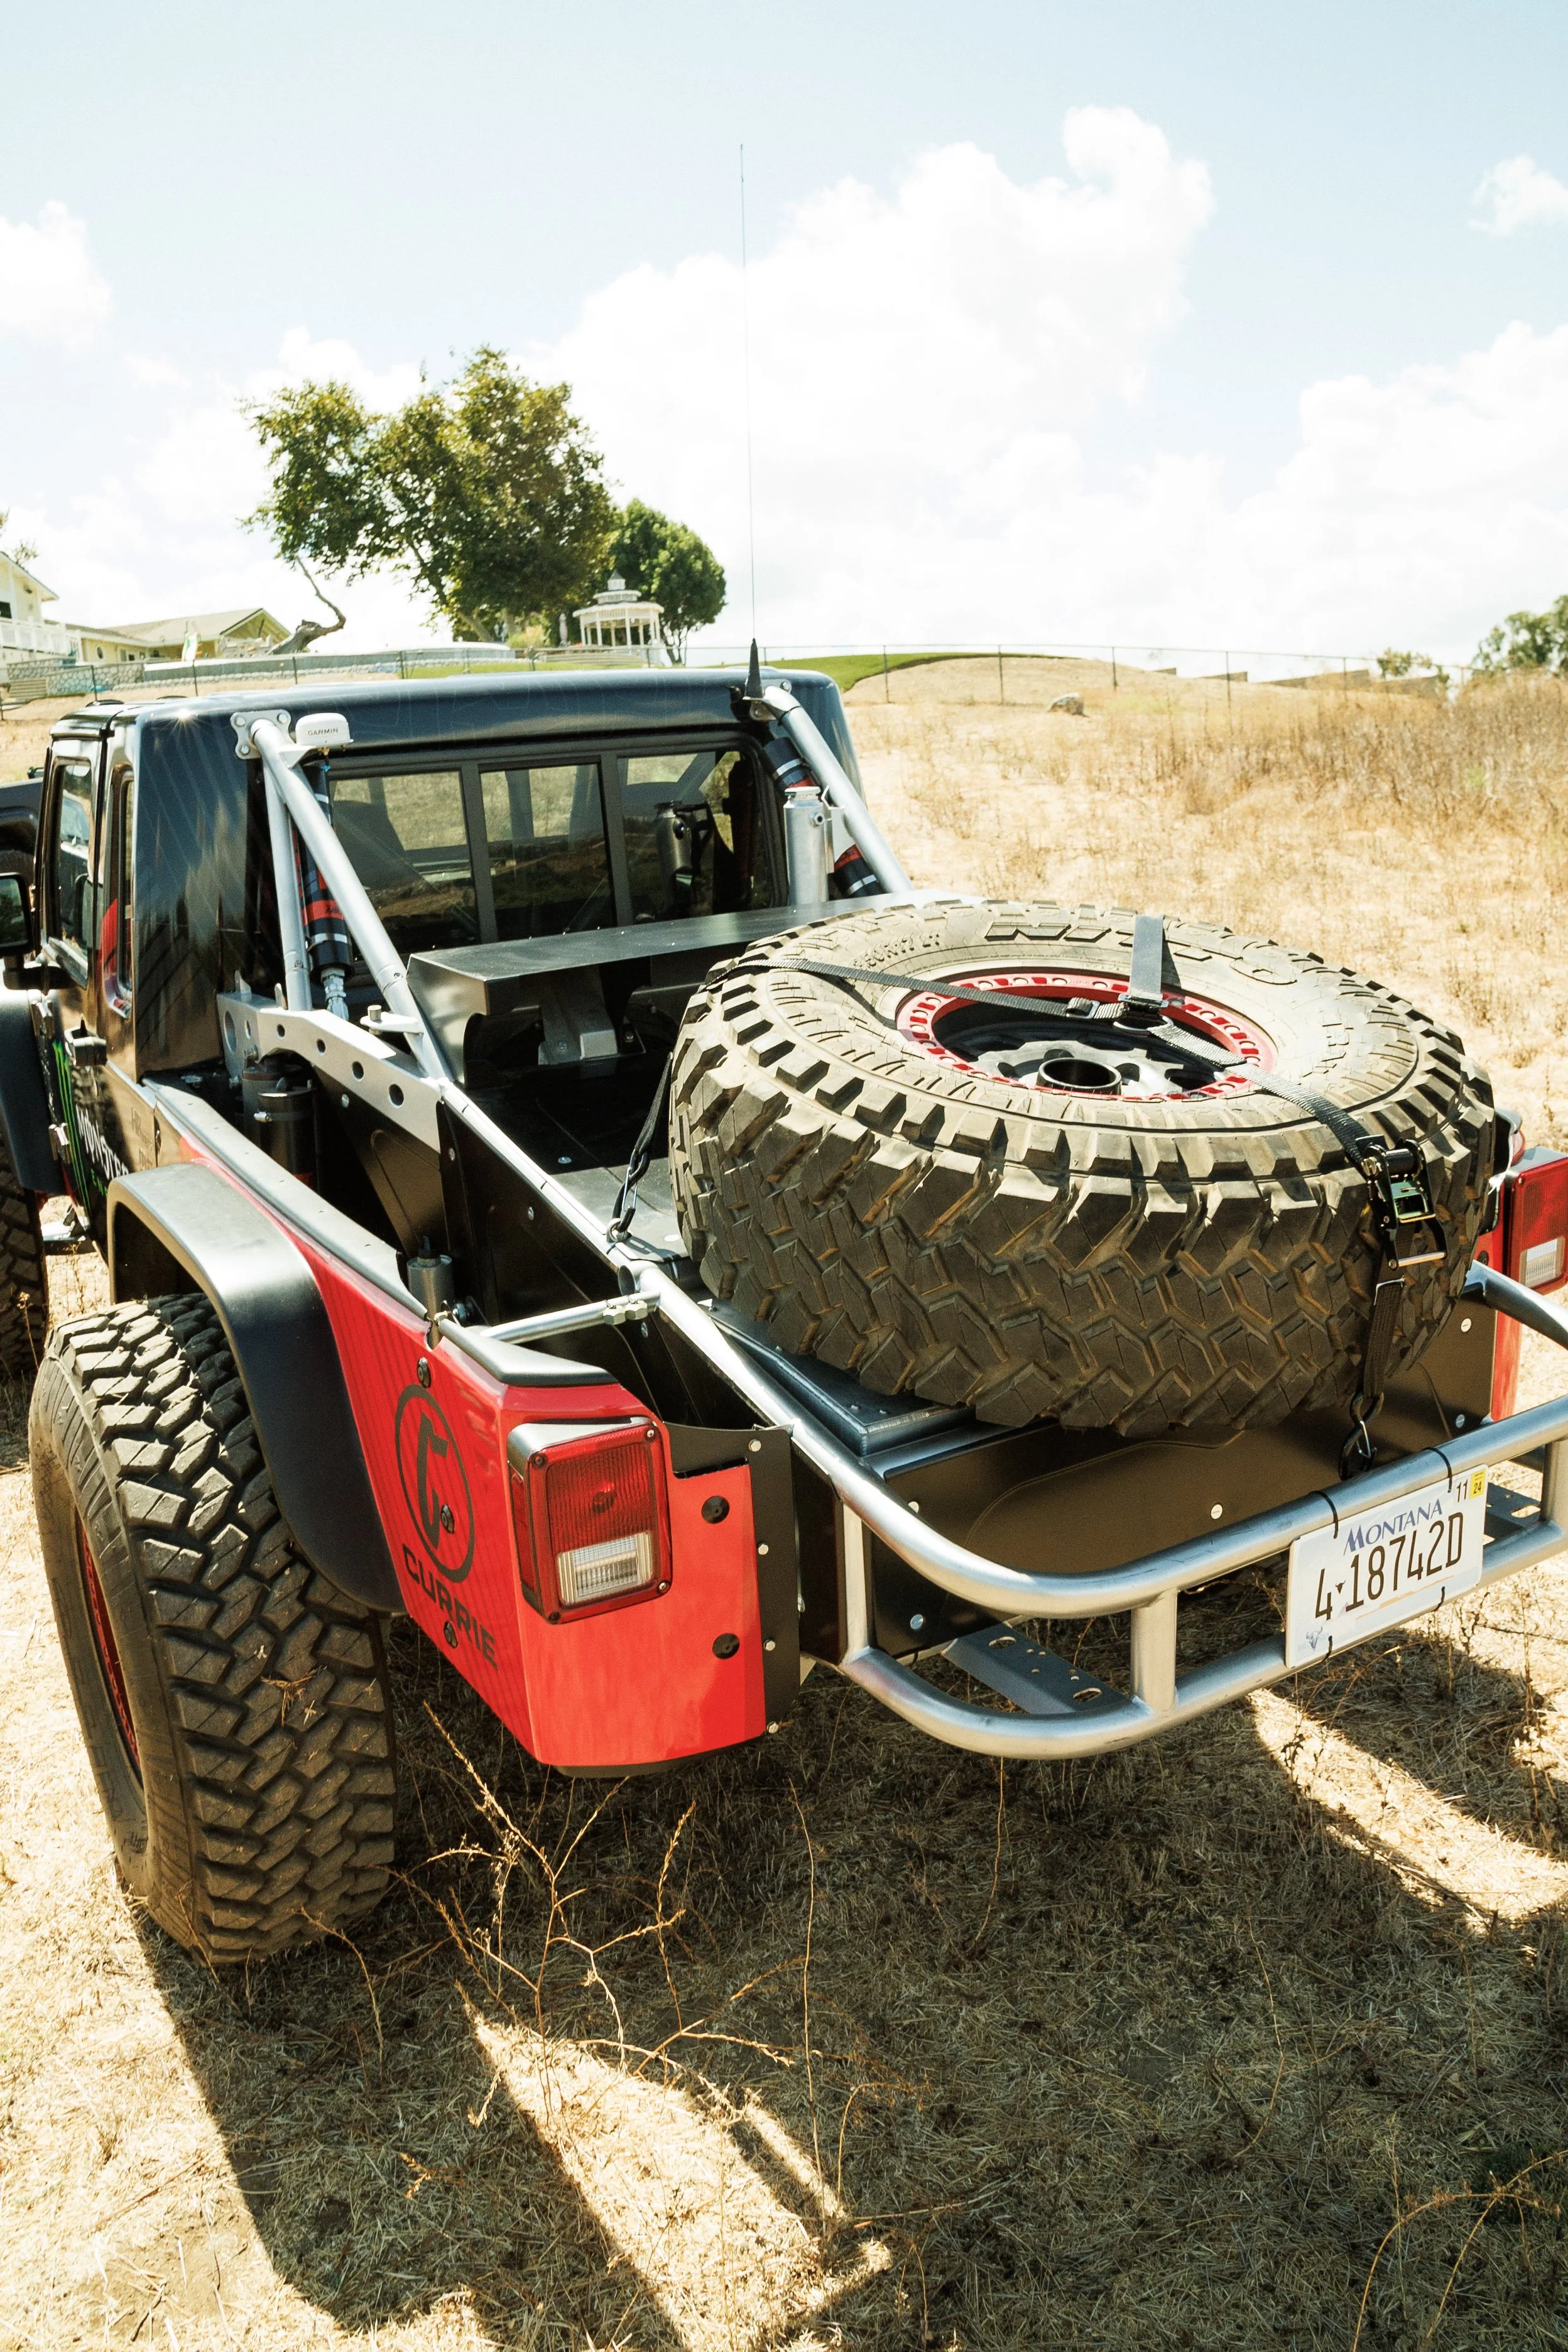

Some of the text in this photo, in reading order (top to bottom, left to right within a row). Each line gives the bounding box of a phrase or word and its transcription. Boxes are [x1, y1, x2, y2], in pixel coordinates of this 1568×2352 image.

[308, 727, 338, 736] GARMIN
[1457, 1479, 1467, 1502] 11
[1473, 1481, 1481, 1494] 24
[1343, 1499, 1442, 1556] MONTANA
[403, 1542, 498, 1671] CURRIE
